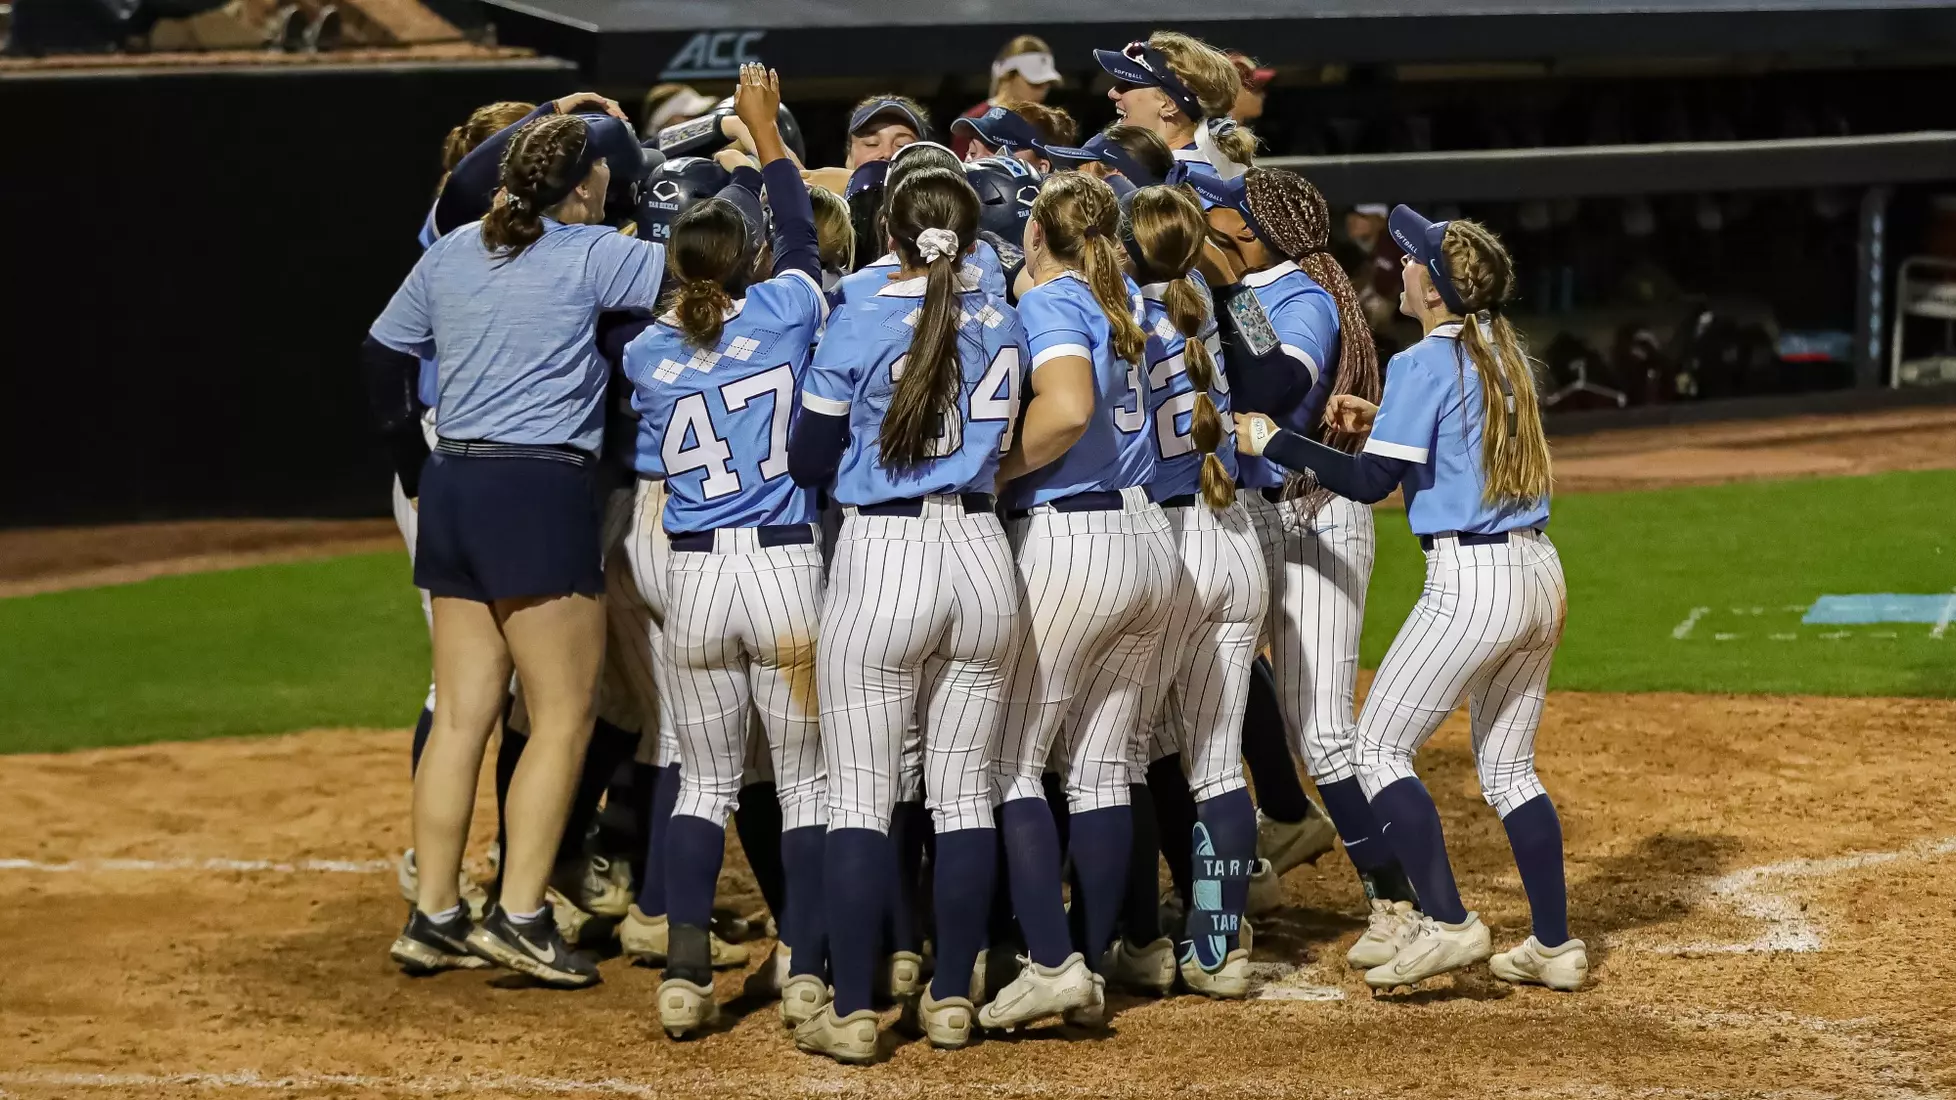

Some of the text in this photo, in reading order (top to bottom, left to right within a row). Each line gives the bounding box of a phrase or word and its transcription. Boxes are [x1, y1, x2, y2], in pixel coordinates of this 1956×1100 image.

[666, 30, 767, 70] ACC
[1113, 67, 1143, 80] SOFTBALL
[1195, 186, 1223, 202] SOFTBALL
[648, 200, 659, 209] TAR
[1017, 209, 1030, 218] TAR
[652, 222, 671, 239] 24
[1393, 229, 1418, 254] SOFTBALL
[660, 361, 797, 502] 47
[1203, 859, 1240, 877] TAR
[1211, 914, 1238, 931] TAR
